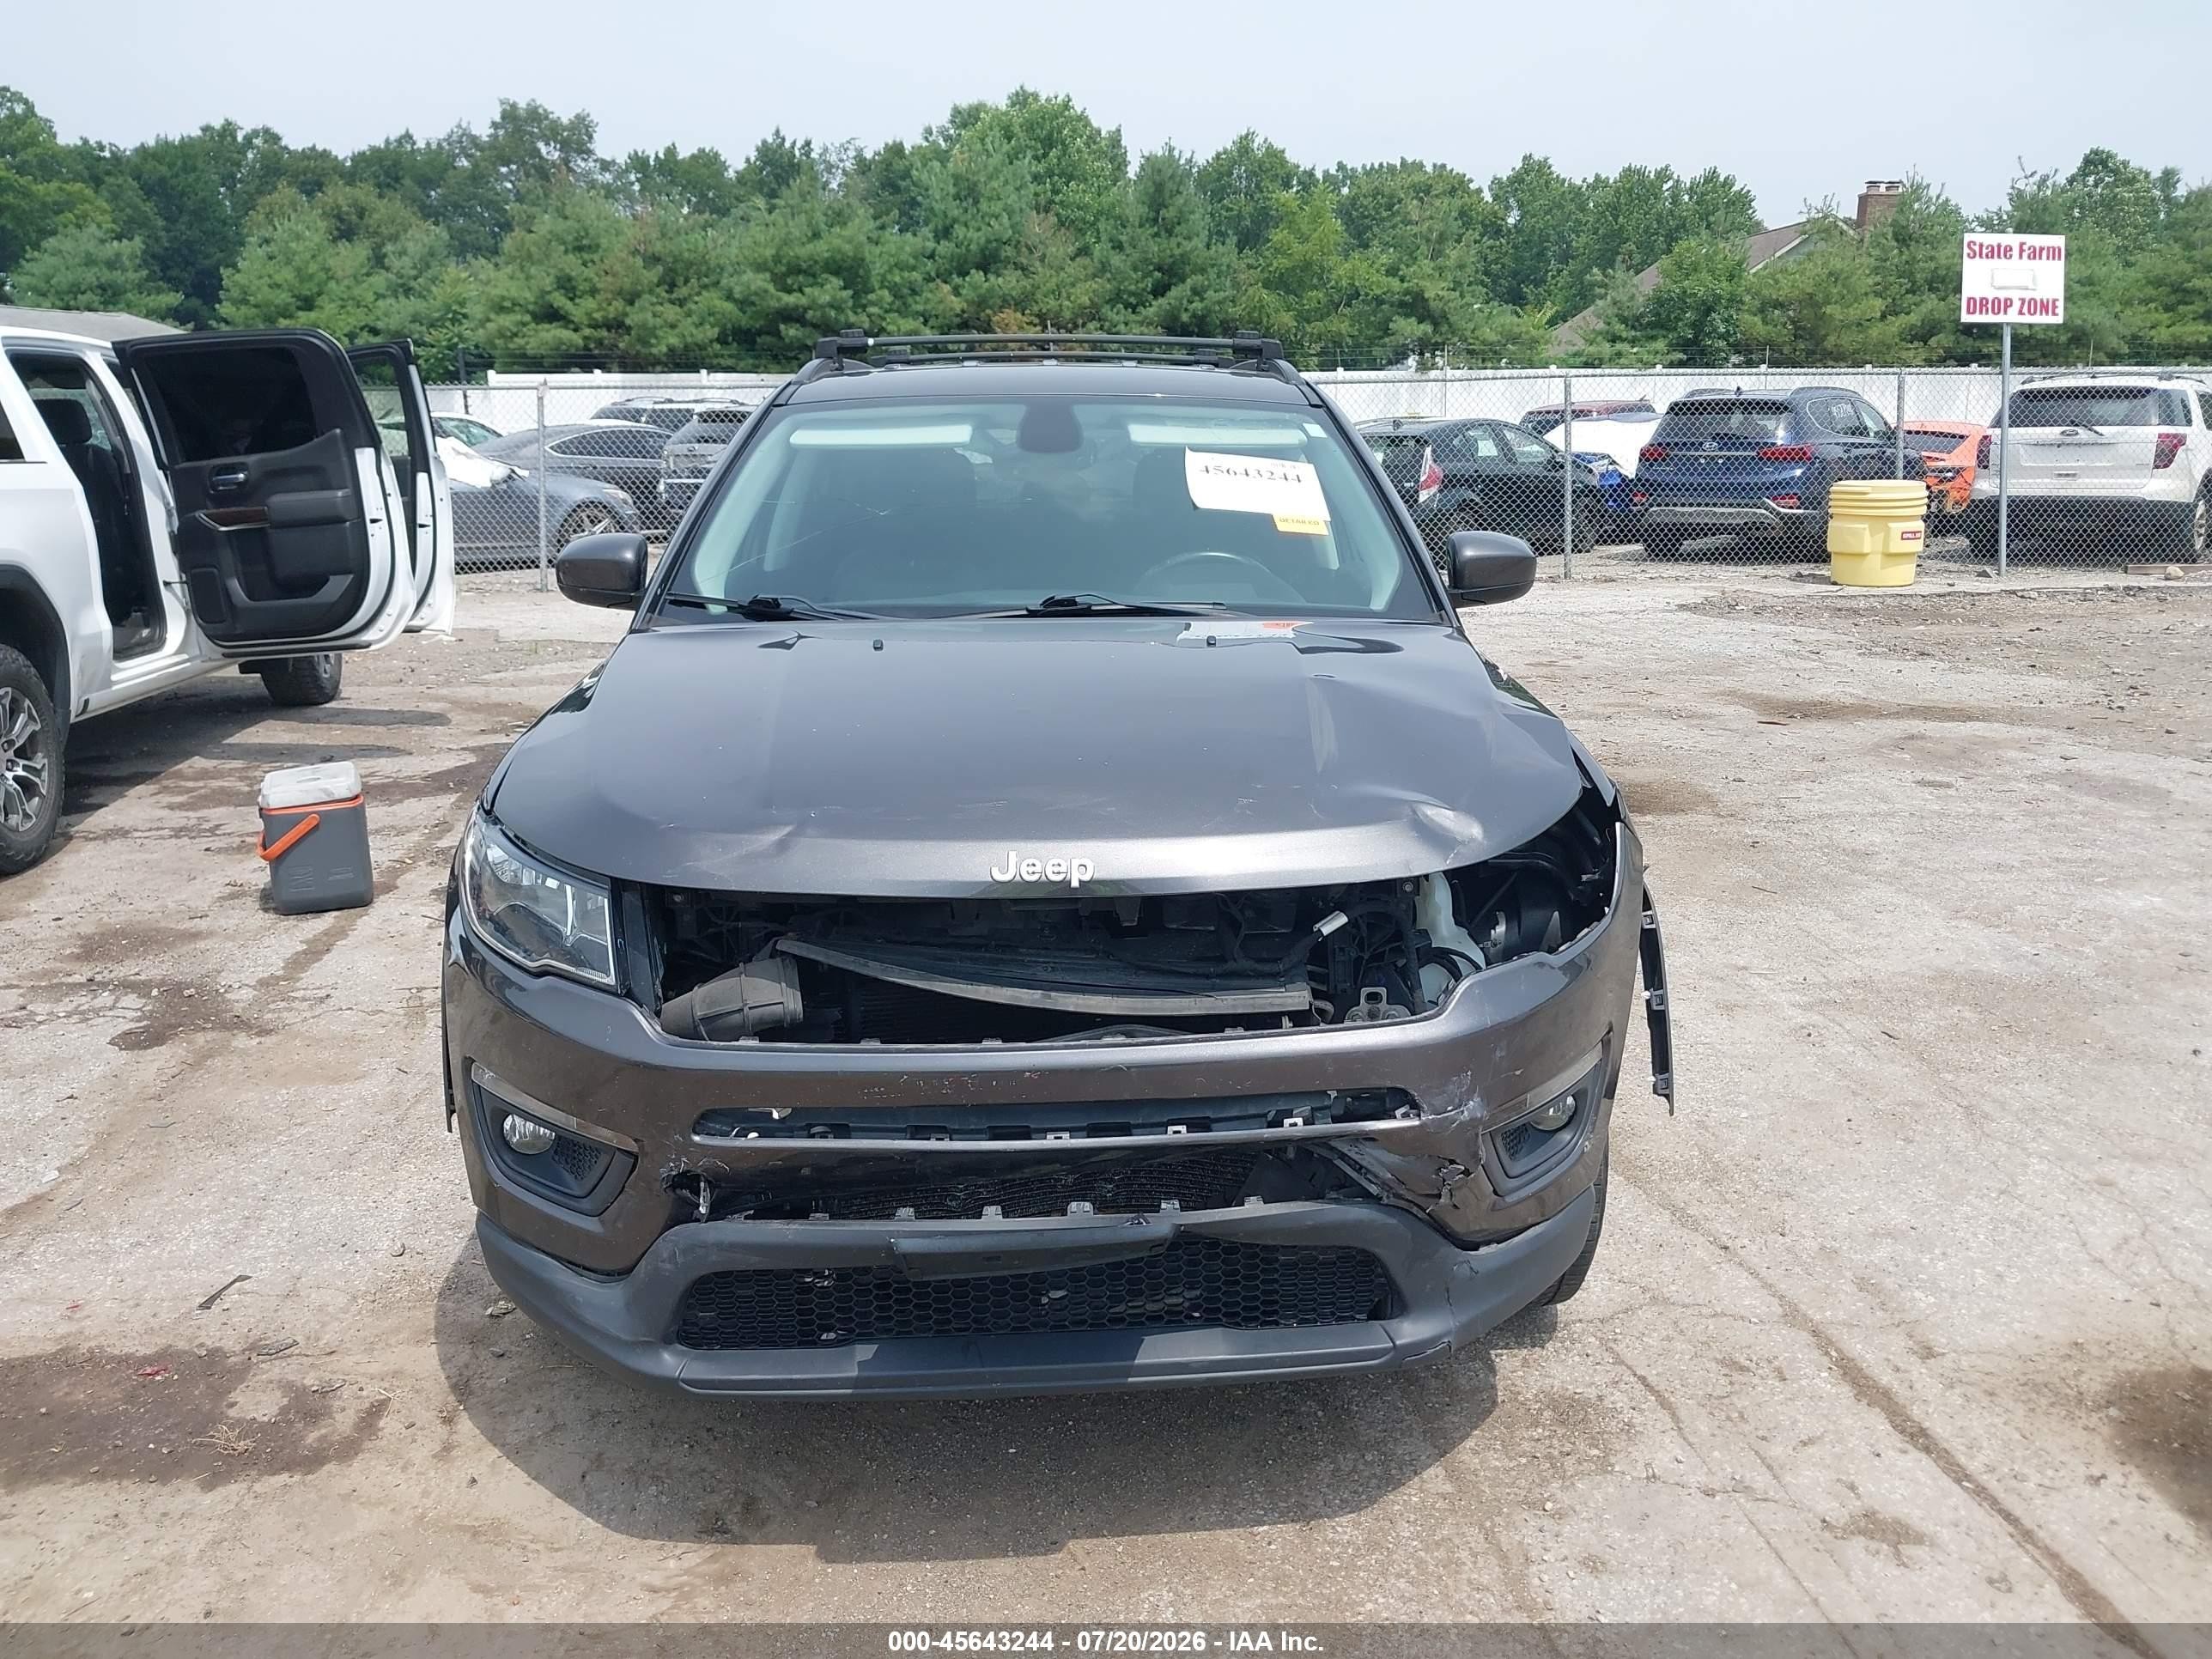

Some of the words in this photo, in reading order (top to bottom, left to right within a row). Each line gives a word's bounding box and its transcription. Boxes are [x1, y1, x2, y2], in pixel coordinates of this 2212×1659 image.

[1966, 240, 2013, 259] State
[2018, 241, 2062, 261] Farm
[1966, 296, 2013, 315] DROP
[2017, 297, 2059, 316] ZONE
[1200, 465, 1302, 483] 45643244
[990, 850, 1096, 888] Jeep
